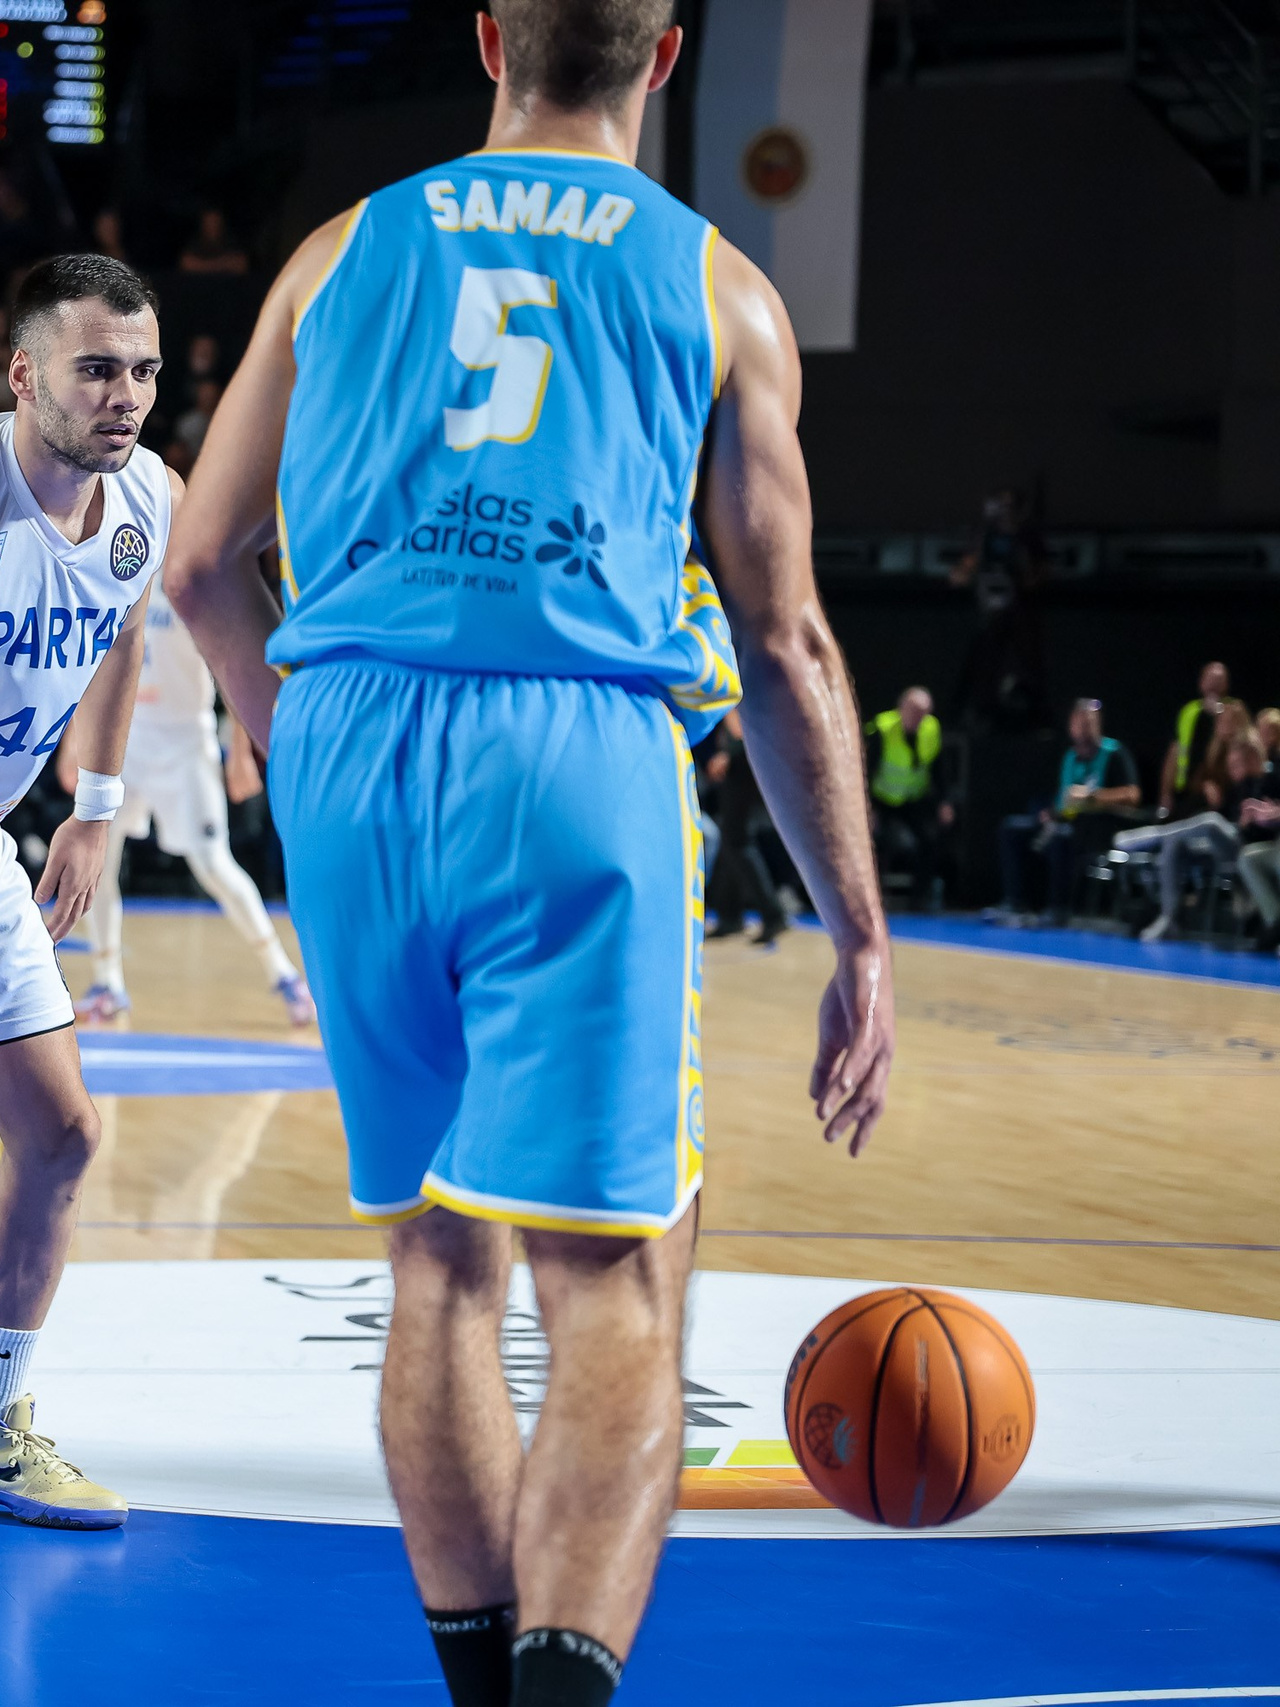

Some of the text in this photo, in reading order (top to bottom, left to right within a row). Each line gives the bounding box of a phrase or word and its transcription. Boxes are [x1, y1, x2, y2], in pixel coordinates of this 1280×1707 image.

[424, 180, 635, 246] SAMAR
[443, 266, 558, 452] 5
[437, 482, 533, 526] slas
[346, 519, 526, 570] Carias
